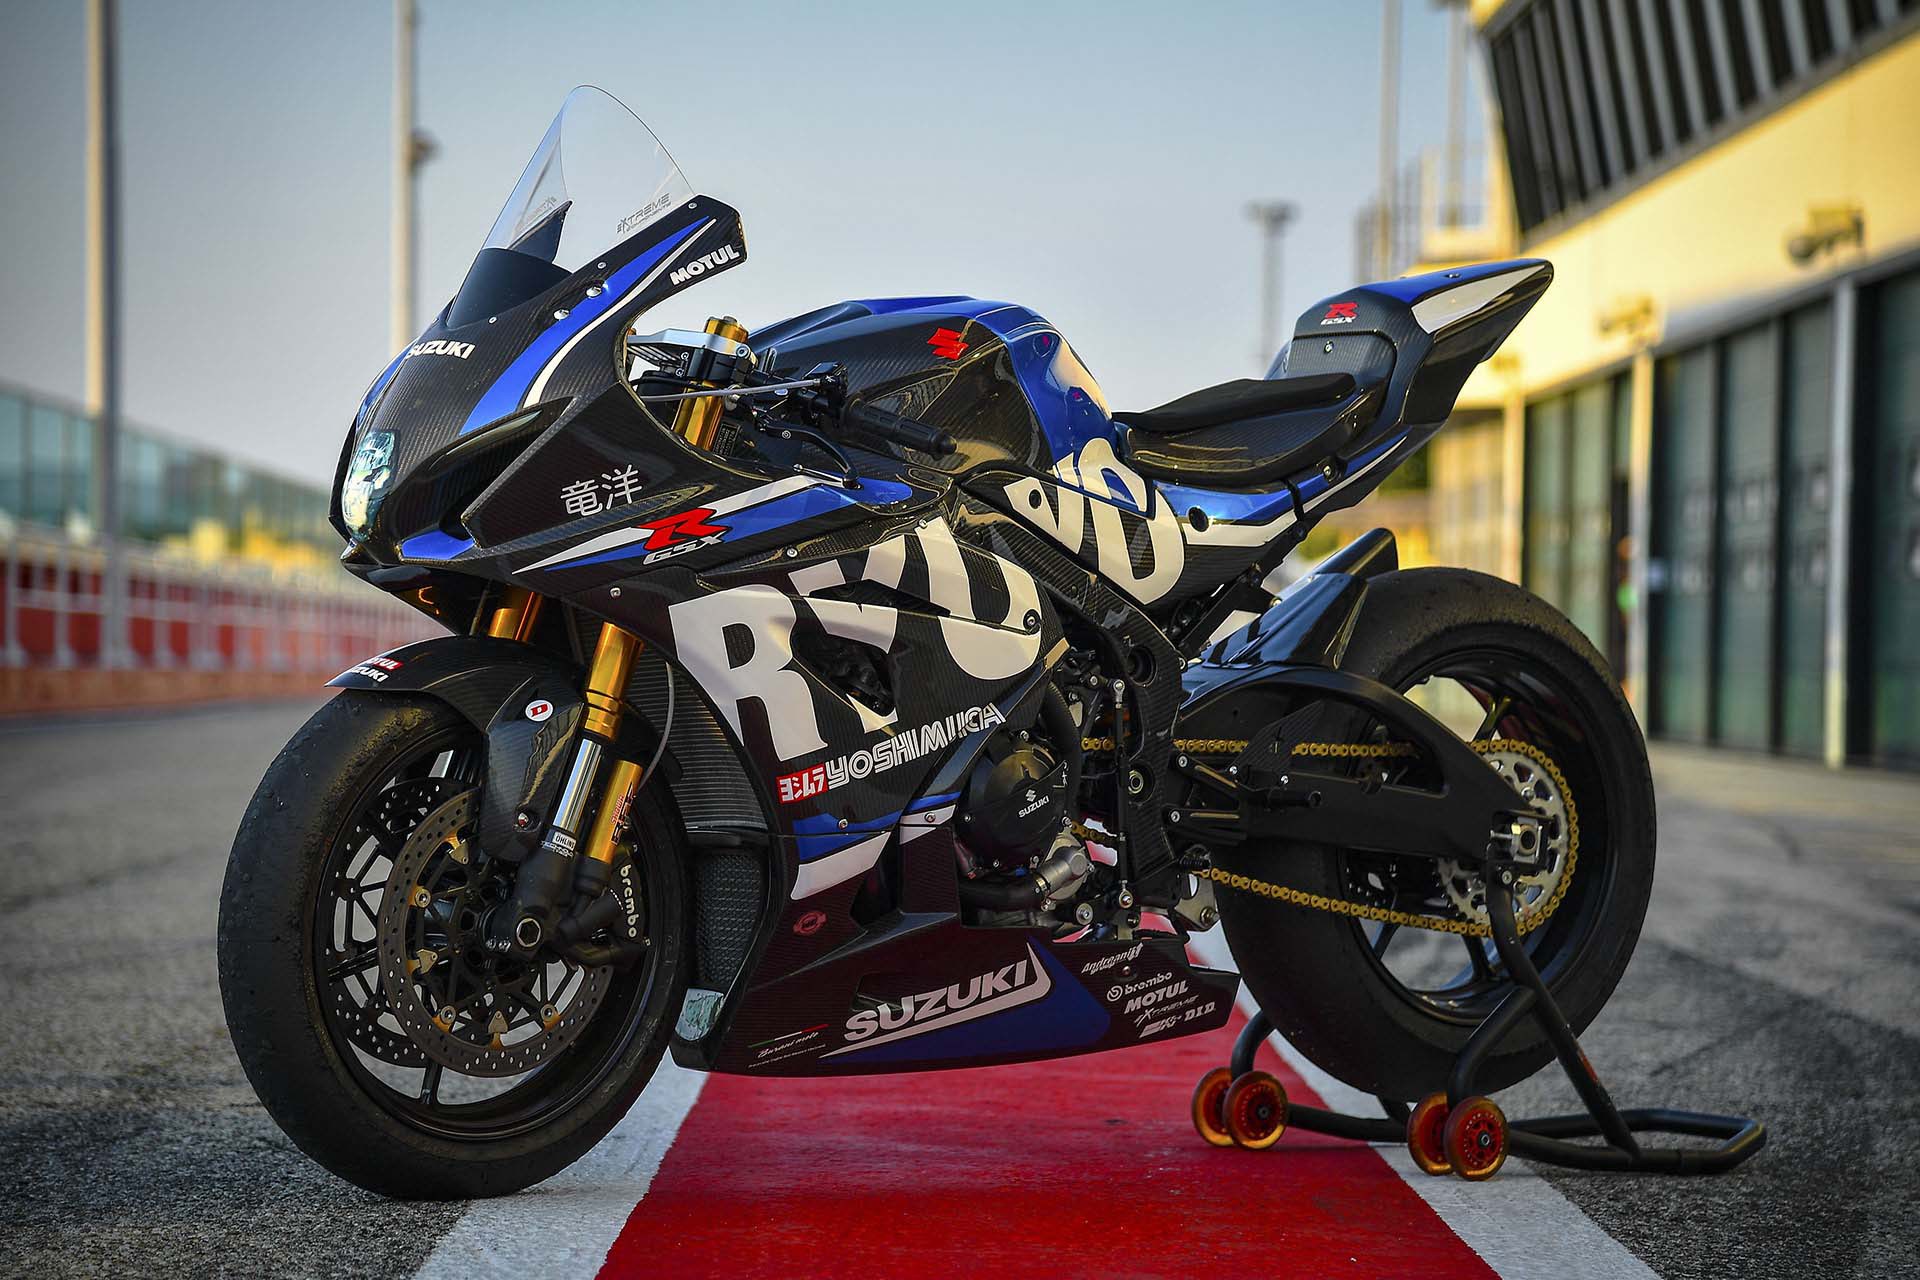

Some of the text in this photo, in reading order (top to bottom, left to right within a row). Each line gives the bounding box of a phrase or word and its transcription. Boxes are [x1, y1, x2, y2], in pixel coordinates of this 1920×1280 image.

[669, 244, 740, 286] MOTUL
[560, 464, 643, 517] 竜洋
[643, 531, 728, 566] GSX
[1018, 795, 1050, 818] SUZUKI
[620, 864, 640, 938] brembo
[844, 959, 1028, 1041] SUZUKI
[1123, 980, 1189, 1014] MOTUL
[1124, 972, 1173, 995] brembo
